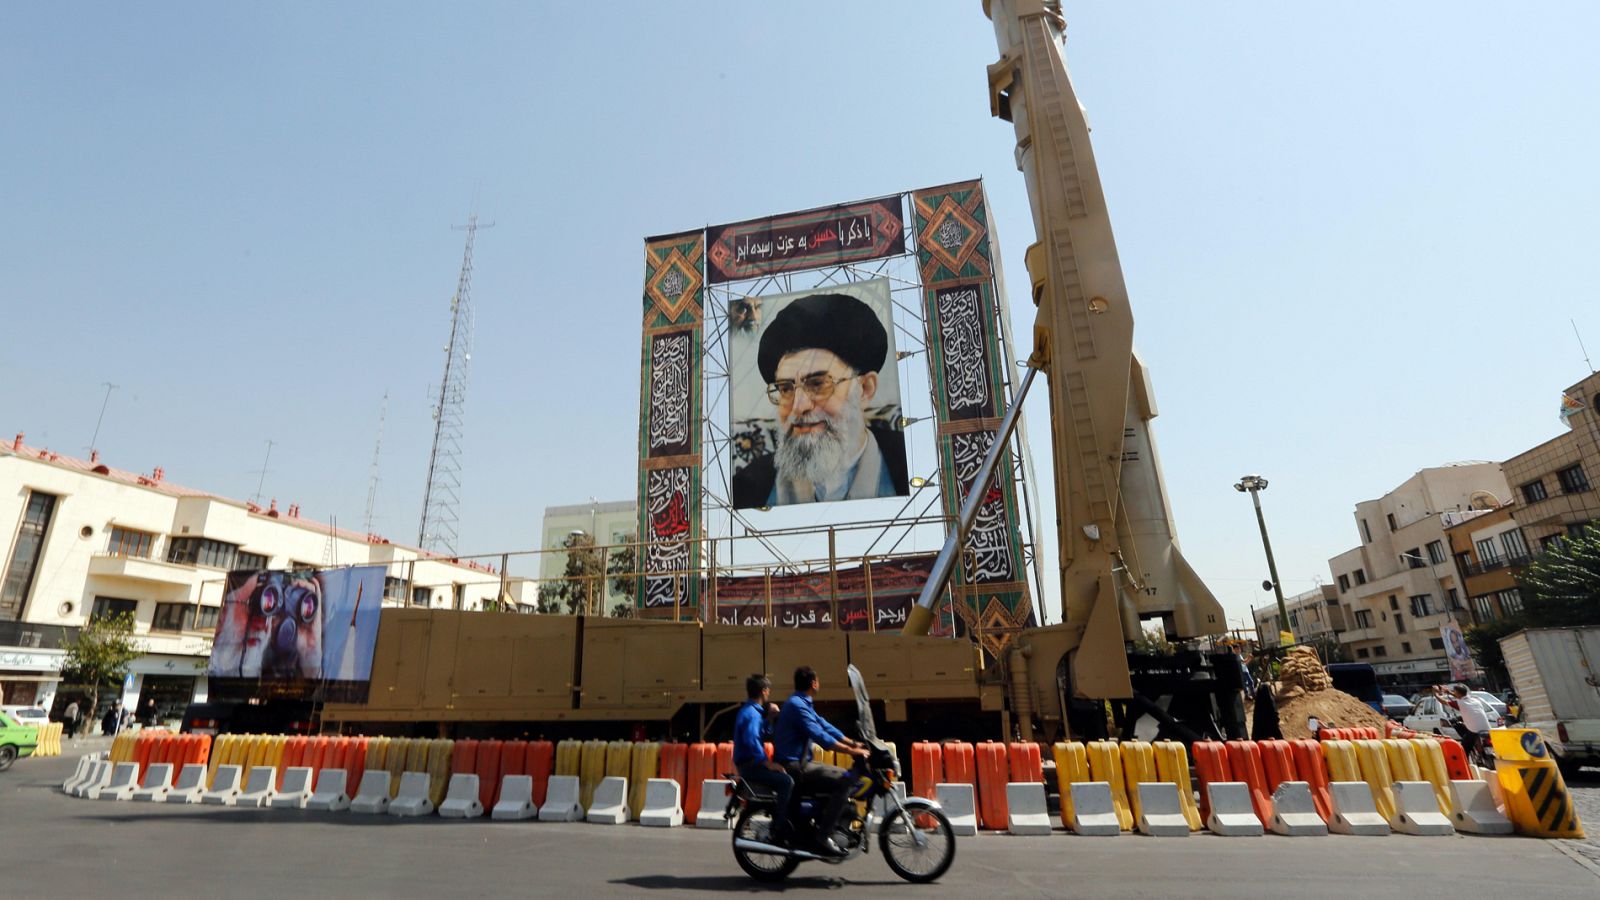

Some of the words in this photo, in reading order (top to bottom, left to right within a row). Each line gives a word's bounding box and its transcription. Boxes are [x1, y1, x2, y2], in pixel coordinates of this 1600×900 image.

[808, 228, 837, 249] حسین
[847, 218, 862, 246] ذکر
[864, 217, 871, 241] با
[750, 241, 773, 258] رسیده
[777, 235, 794, 256] عزت
[799, 235, 807, 250] به
[1145, 587, 1157, 596] 17
[783, 609, 816, 628] قدرت
[875, 606, 906, 624] پرچم
